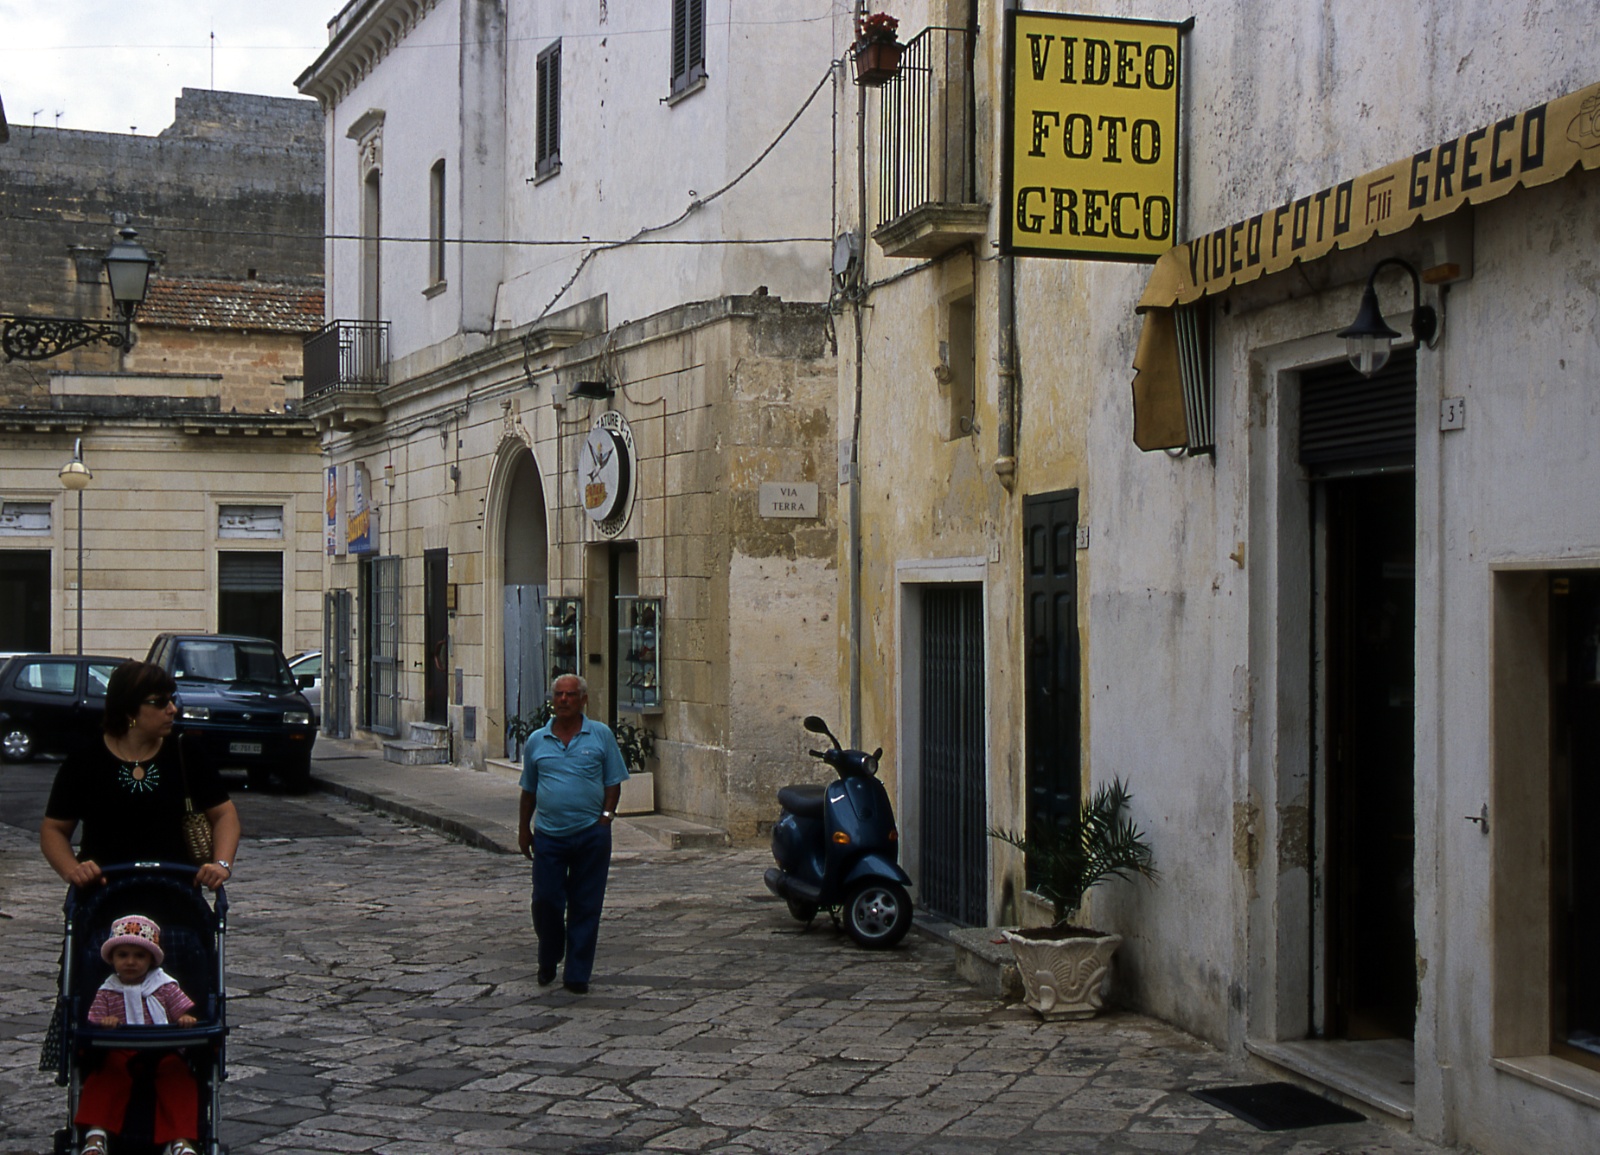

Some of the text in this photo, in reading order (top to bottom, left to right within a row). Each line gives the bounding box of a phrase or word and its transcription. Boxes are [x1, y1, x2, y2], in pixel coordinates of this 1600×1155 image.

[1026, 33, 1175, 90] VIDEO
[1028, 110, 1161, 165] FOTO
[1016, 186, 1171, 241] GRECO
[1185, 103, 1547, 287] VIDEO FOTO F.lli GRECO
[1448, 405, 1455, 423] 3
[772, 502, 805, 511] TERRA
[780, 487, 798, 497] VIA
